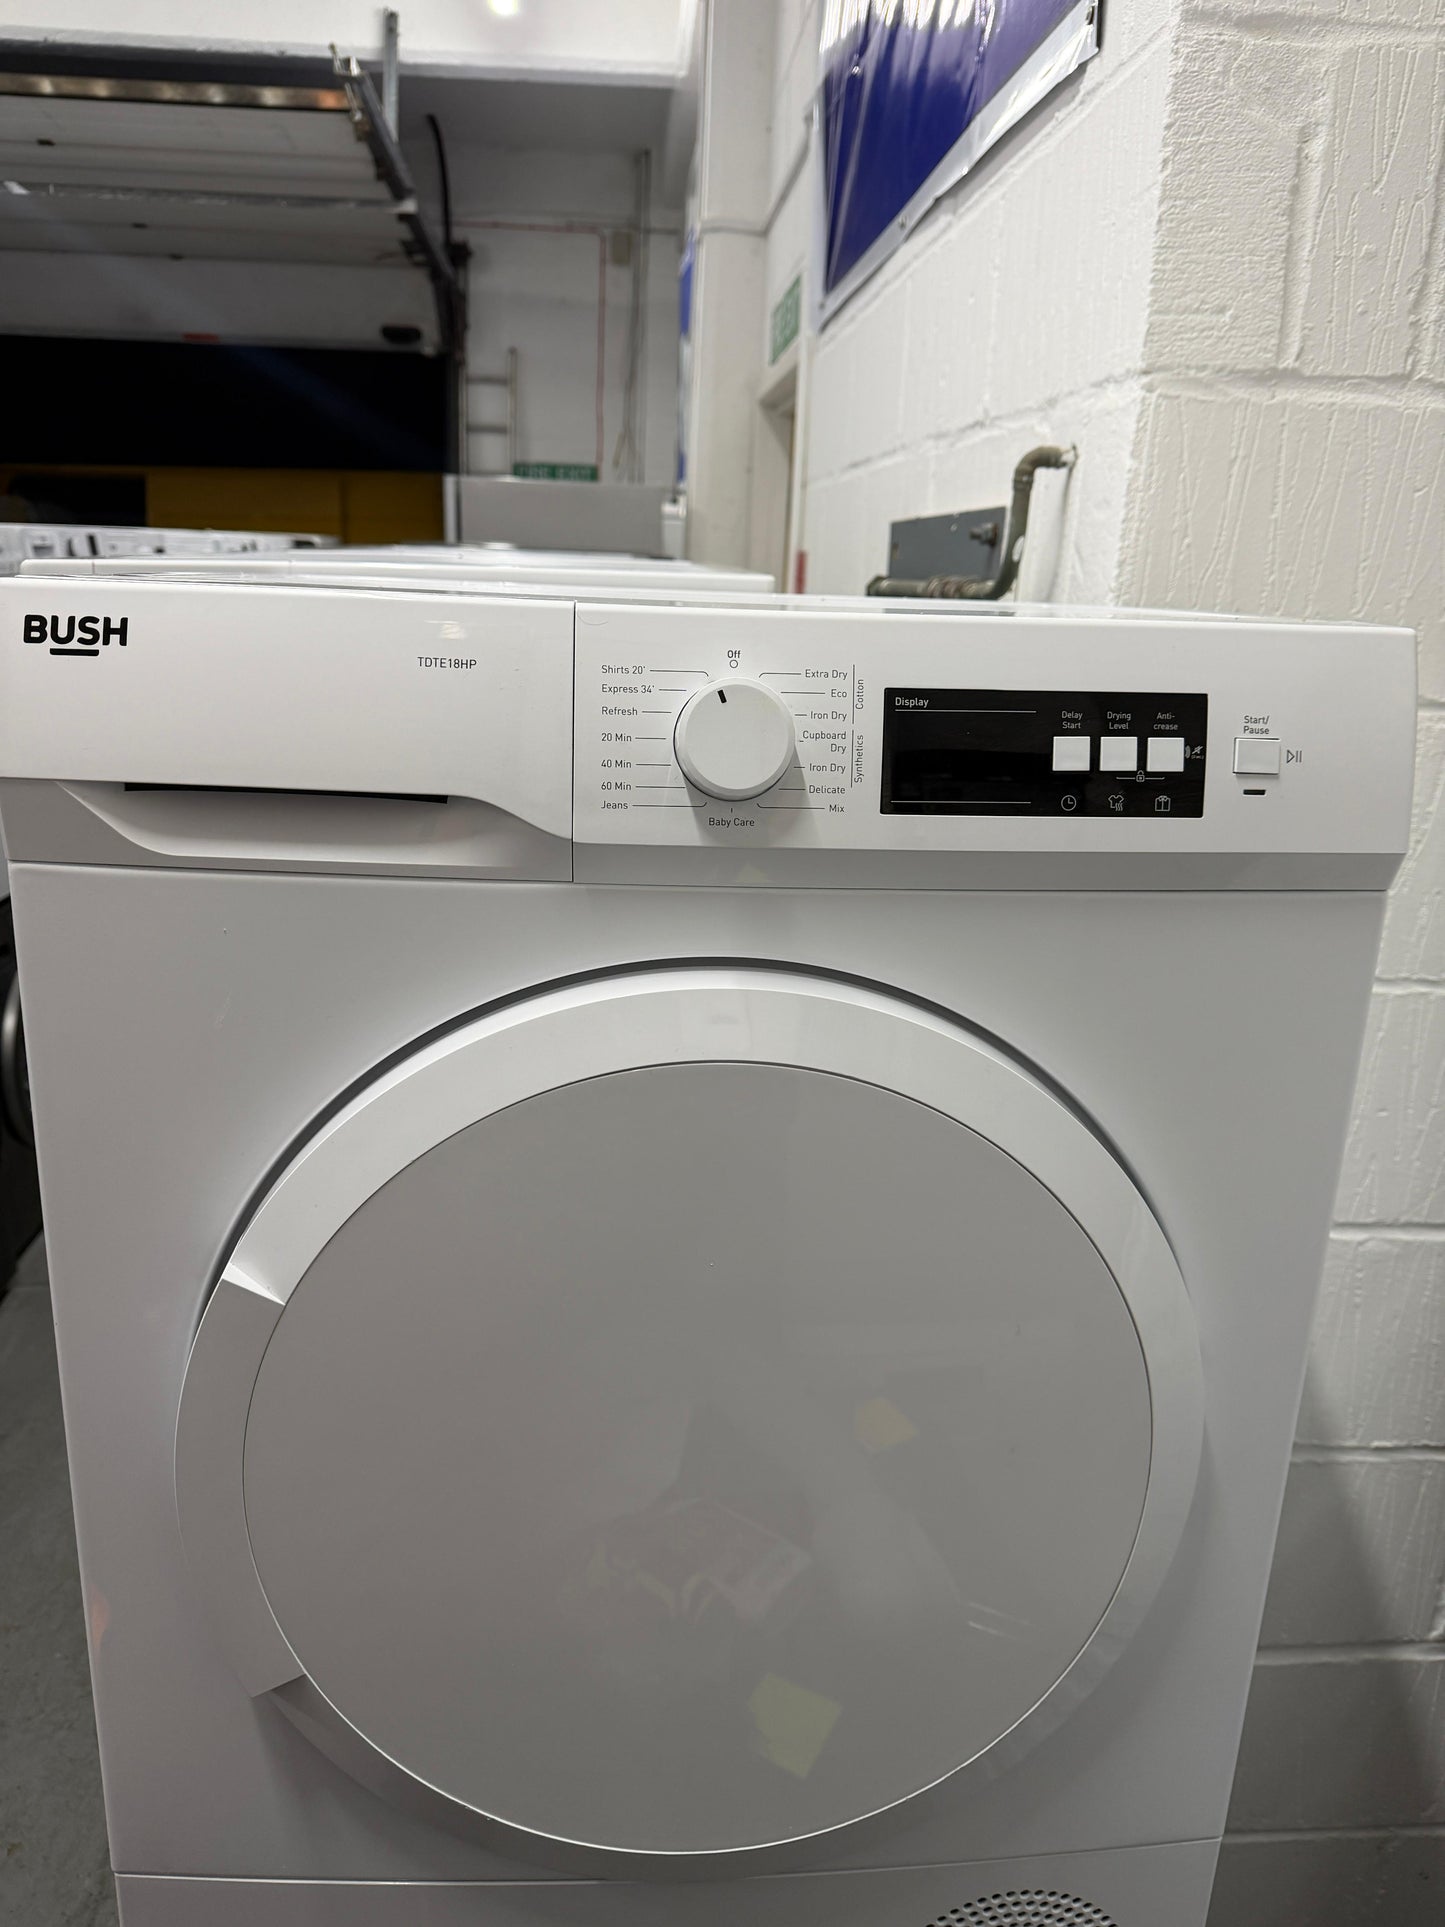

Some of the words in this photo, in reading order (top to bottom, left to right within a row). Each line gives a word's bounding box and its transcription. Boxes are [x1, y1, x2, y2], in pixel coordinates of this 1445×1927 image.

[23, 614, 128, 646] BUSH
[727, 649, 741, 659] Off
[417, 656, 478, 670] TDTE18HP
[601, 664, 630, 675] Shirts
[805, 668, 829, 679] Extra
[831, 669, 848, 681] Dry
[601, 683, 639, 695] Express
[830, 688, 848, 698] Eco
[854, 678, 865, 711] Cotton
[894, 696, 929, 709] Display
[601, 705, 638, 716] Refresh
[1061, 710, 1083, 721] Delay
[1106, 710, 1132, 722] Drying
[1156, 711, 1176, 720] Anti-
[810, 710, 829, 720] Iron
[831, 710, 848, 723] Dry
[1243, 714, 1270, 725] Start/
[1062, 720, 1082, 730] Start
[1108, 721, 1129, 730] Level
[1153, 723, 1179, 731] crease
[1243, 725, 1270, 735] Pause
[601, 732, 613, 742] 20
[614, 732, 632, 742] Min
[802, 730, 847, 743] Cupboard
[830, 743, 847, 755] Dry
[600, 758, 613, 769] 40
[614, 759, 632, 769] Min
[853, 734, 865, 784] Synthetics
[809, 762, 828, 772] Iron
[829, 762, 847, 775] Dry
[600, 781, 613, 791] 60
[614, 781, 632, 791] Min
[808, 784, 846, 795] Delicate
[600, 800, 629, 810] Jeans
[828, 803, 845, 813] Mix
[708, 816, 732, 829] Baby
[733, 817, 755, 827] Care
